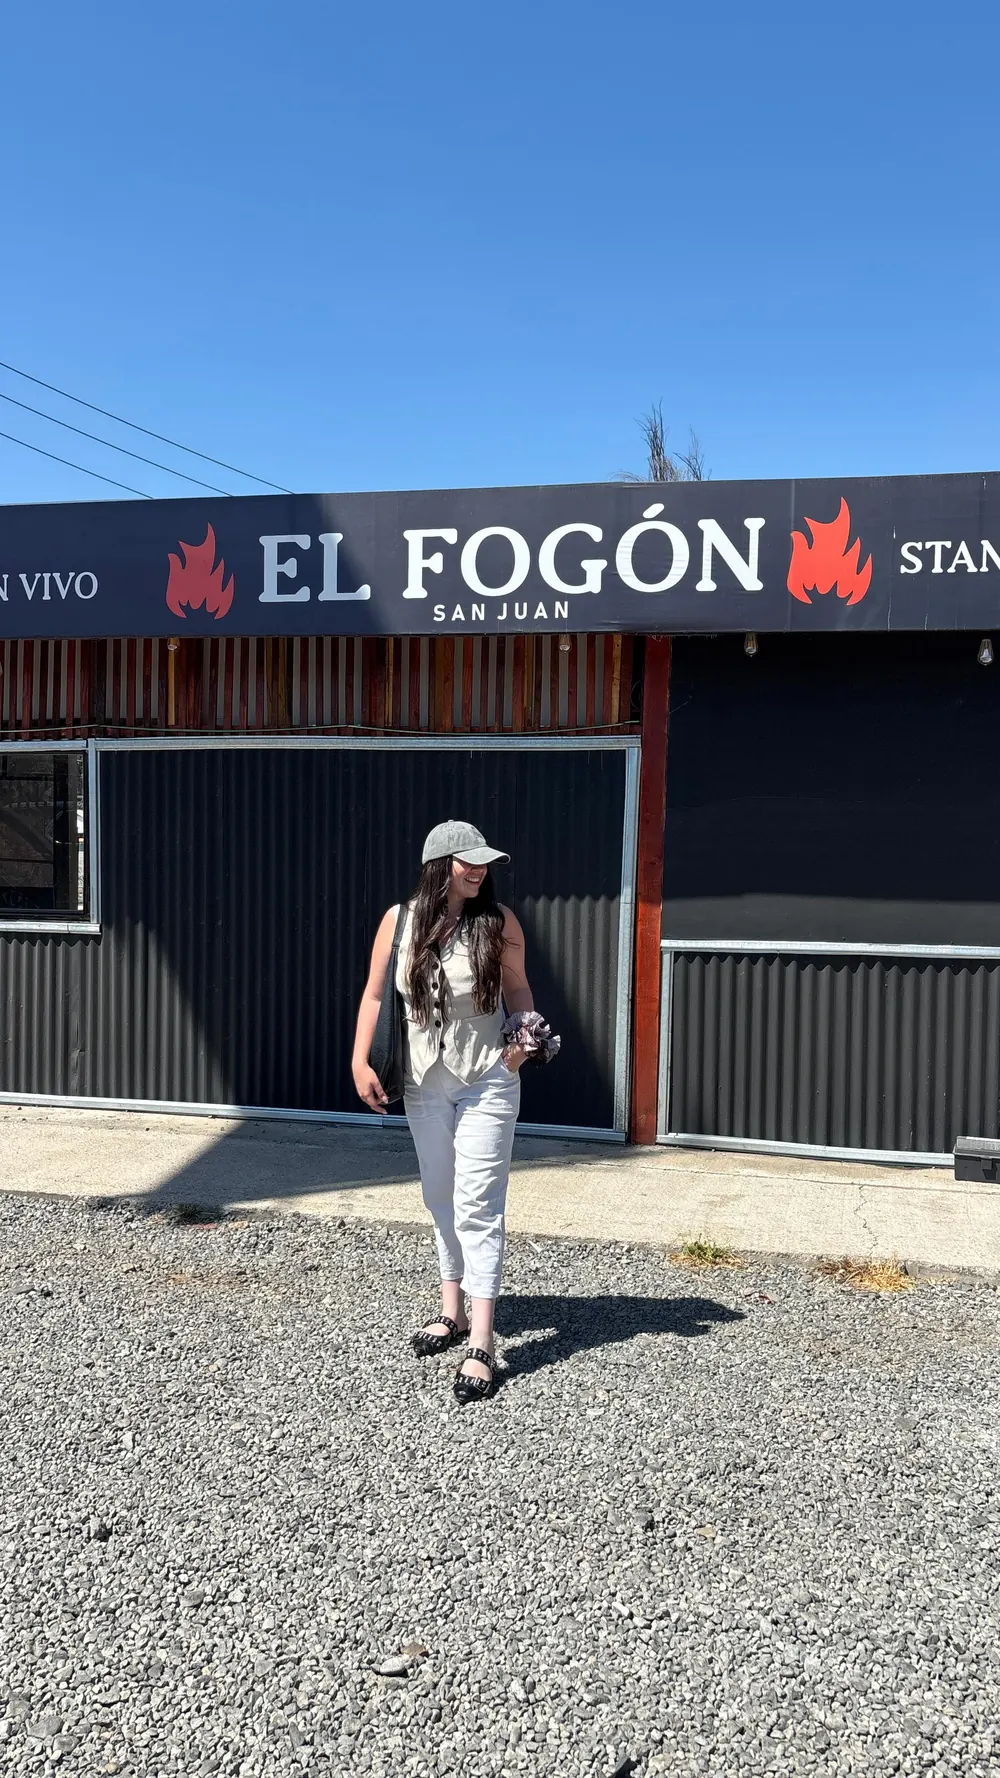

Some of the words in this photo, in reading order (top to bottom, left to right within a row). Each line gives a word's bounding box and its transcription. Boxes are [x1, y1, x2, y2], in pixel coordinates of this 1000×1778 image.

[258, 532, 371, 603] EL
[402, 503, 766, 600] FOGÓN
[18, 571, 98, 601] VIVO
[432, 603, 486, 622] SAN
[496, 601, 569, 621] JUAN
